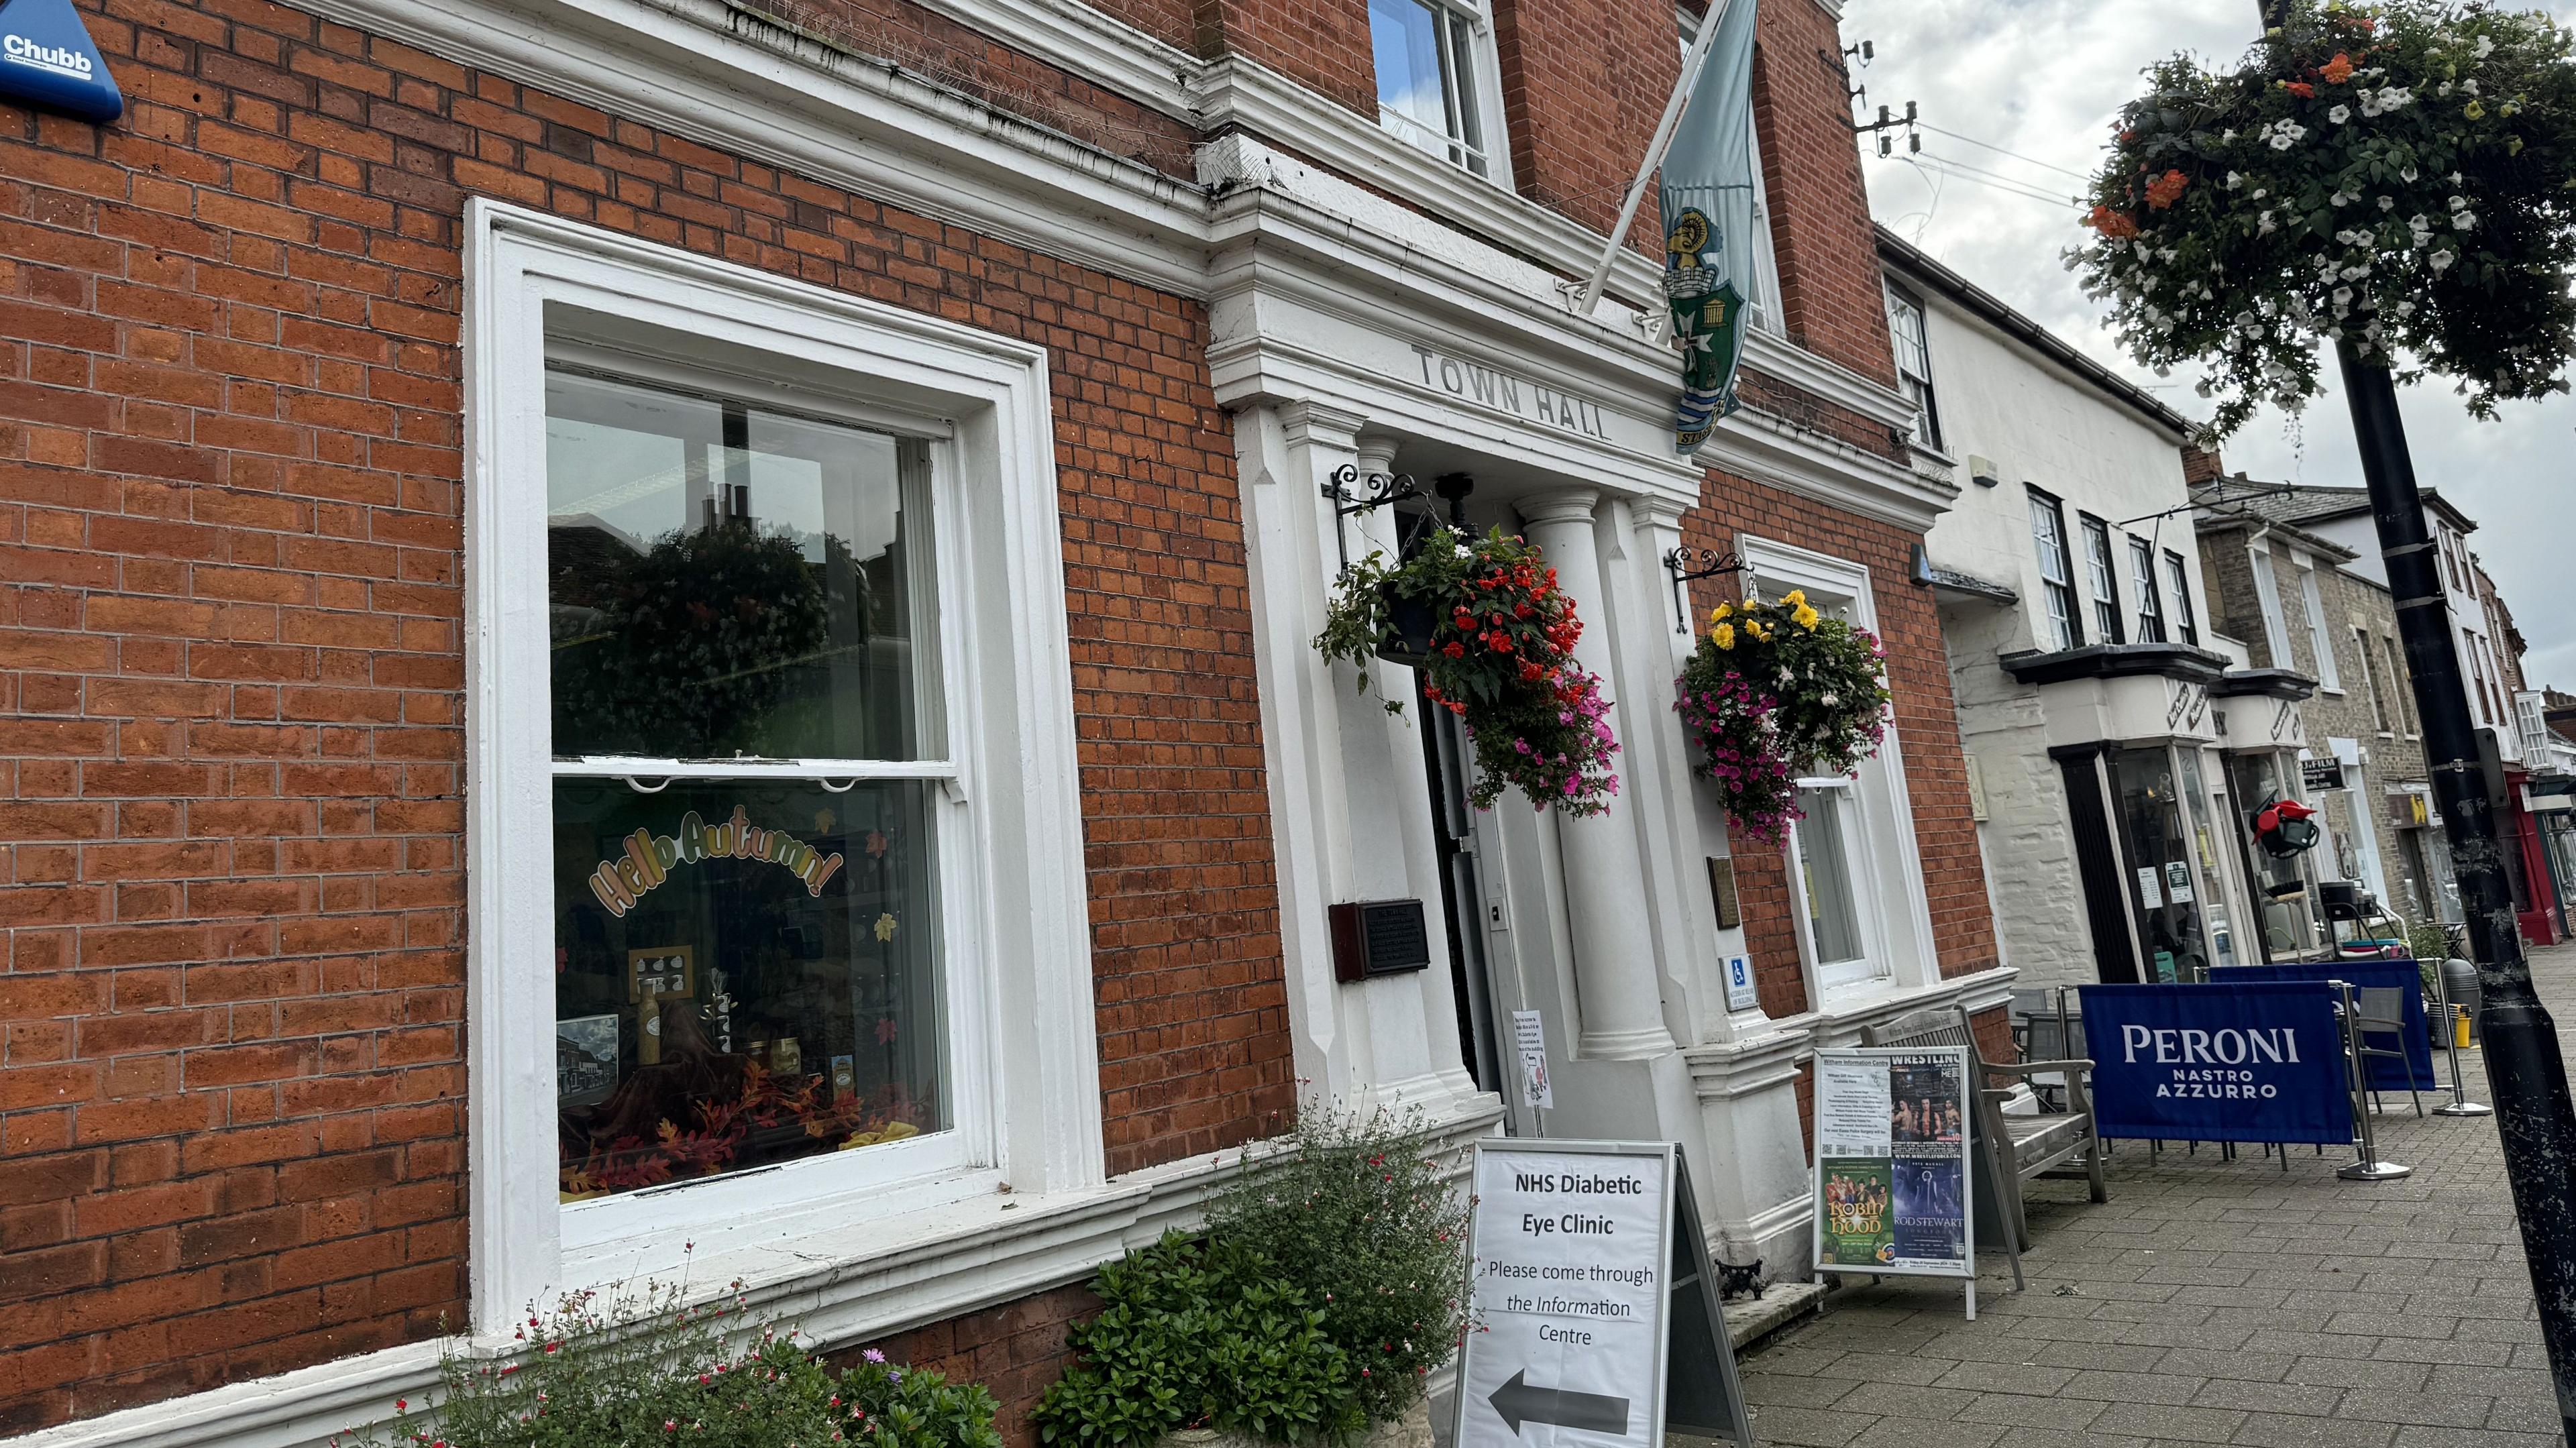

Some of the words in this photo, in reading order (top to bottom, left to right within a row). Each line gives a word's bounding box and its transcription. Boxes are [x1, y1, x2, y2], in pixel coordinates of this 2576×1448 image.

[3, 34, 92, 72] Chubb
[1411, 343, 1521, 413] TOWN
[1534, 385, 1612, 441] HALL
[590, 828, 676, 917] Hello
[681, 805, 843, 897] Autumn!
[2121, 1024, 2300, 1064] PERONI
[2173, 1069, 2253, 1082] NASTRO
[2156, 1084, 2277, 1099] AZZURRO
[1515, 1174, 1554, 1193] NHS
[1561, 1174, 1642, 1194] Diabetic
[1522, 1214, 1555, 1236] Eye
[1560, 1213, 1614, 1235] Clinic
[1894, 1217, 1915, 1226] ROD
[1916, 1217, 1964, 1227] STEWART
[1489, 1261, 1538, 1279] Please
[1542, 1265, 1585, 1280] come
[1590, 1264, 1654, 1286] through
[1507, 1294, 1533, 1312] the
[1536, 1296, 1630, 1317] Information
[1539, 1324, 1592, 1345] Centre
